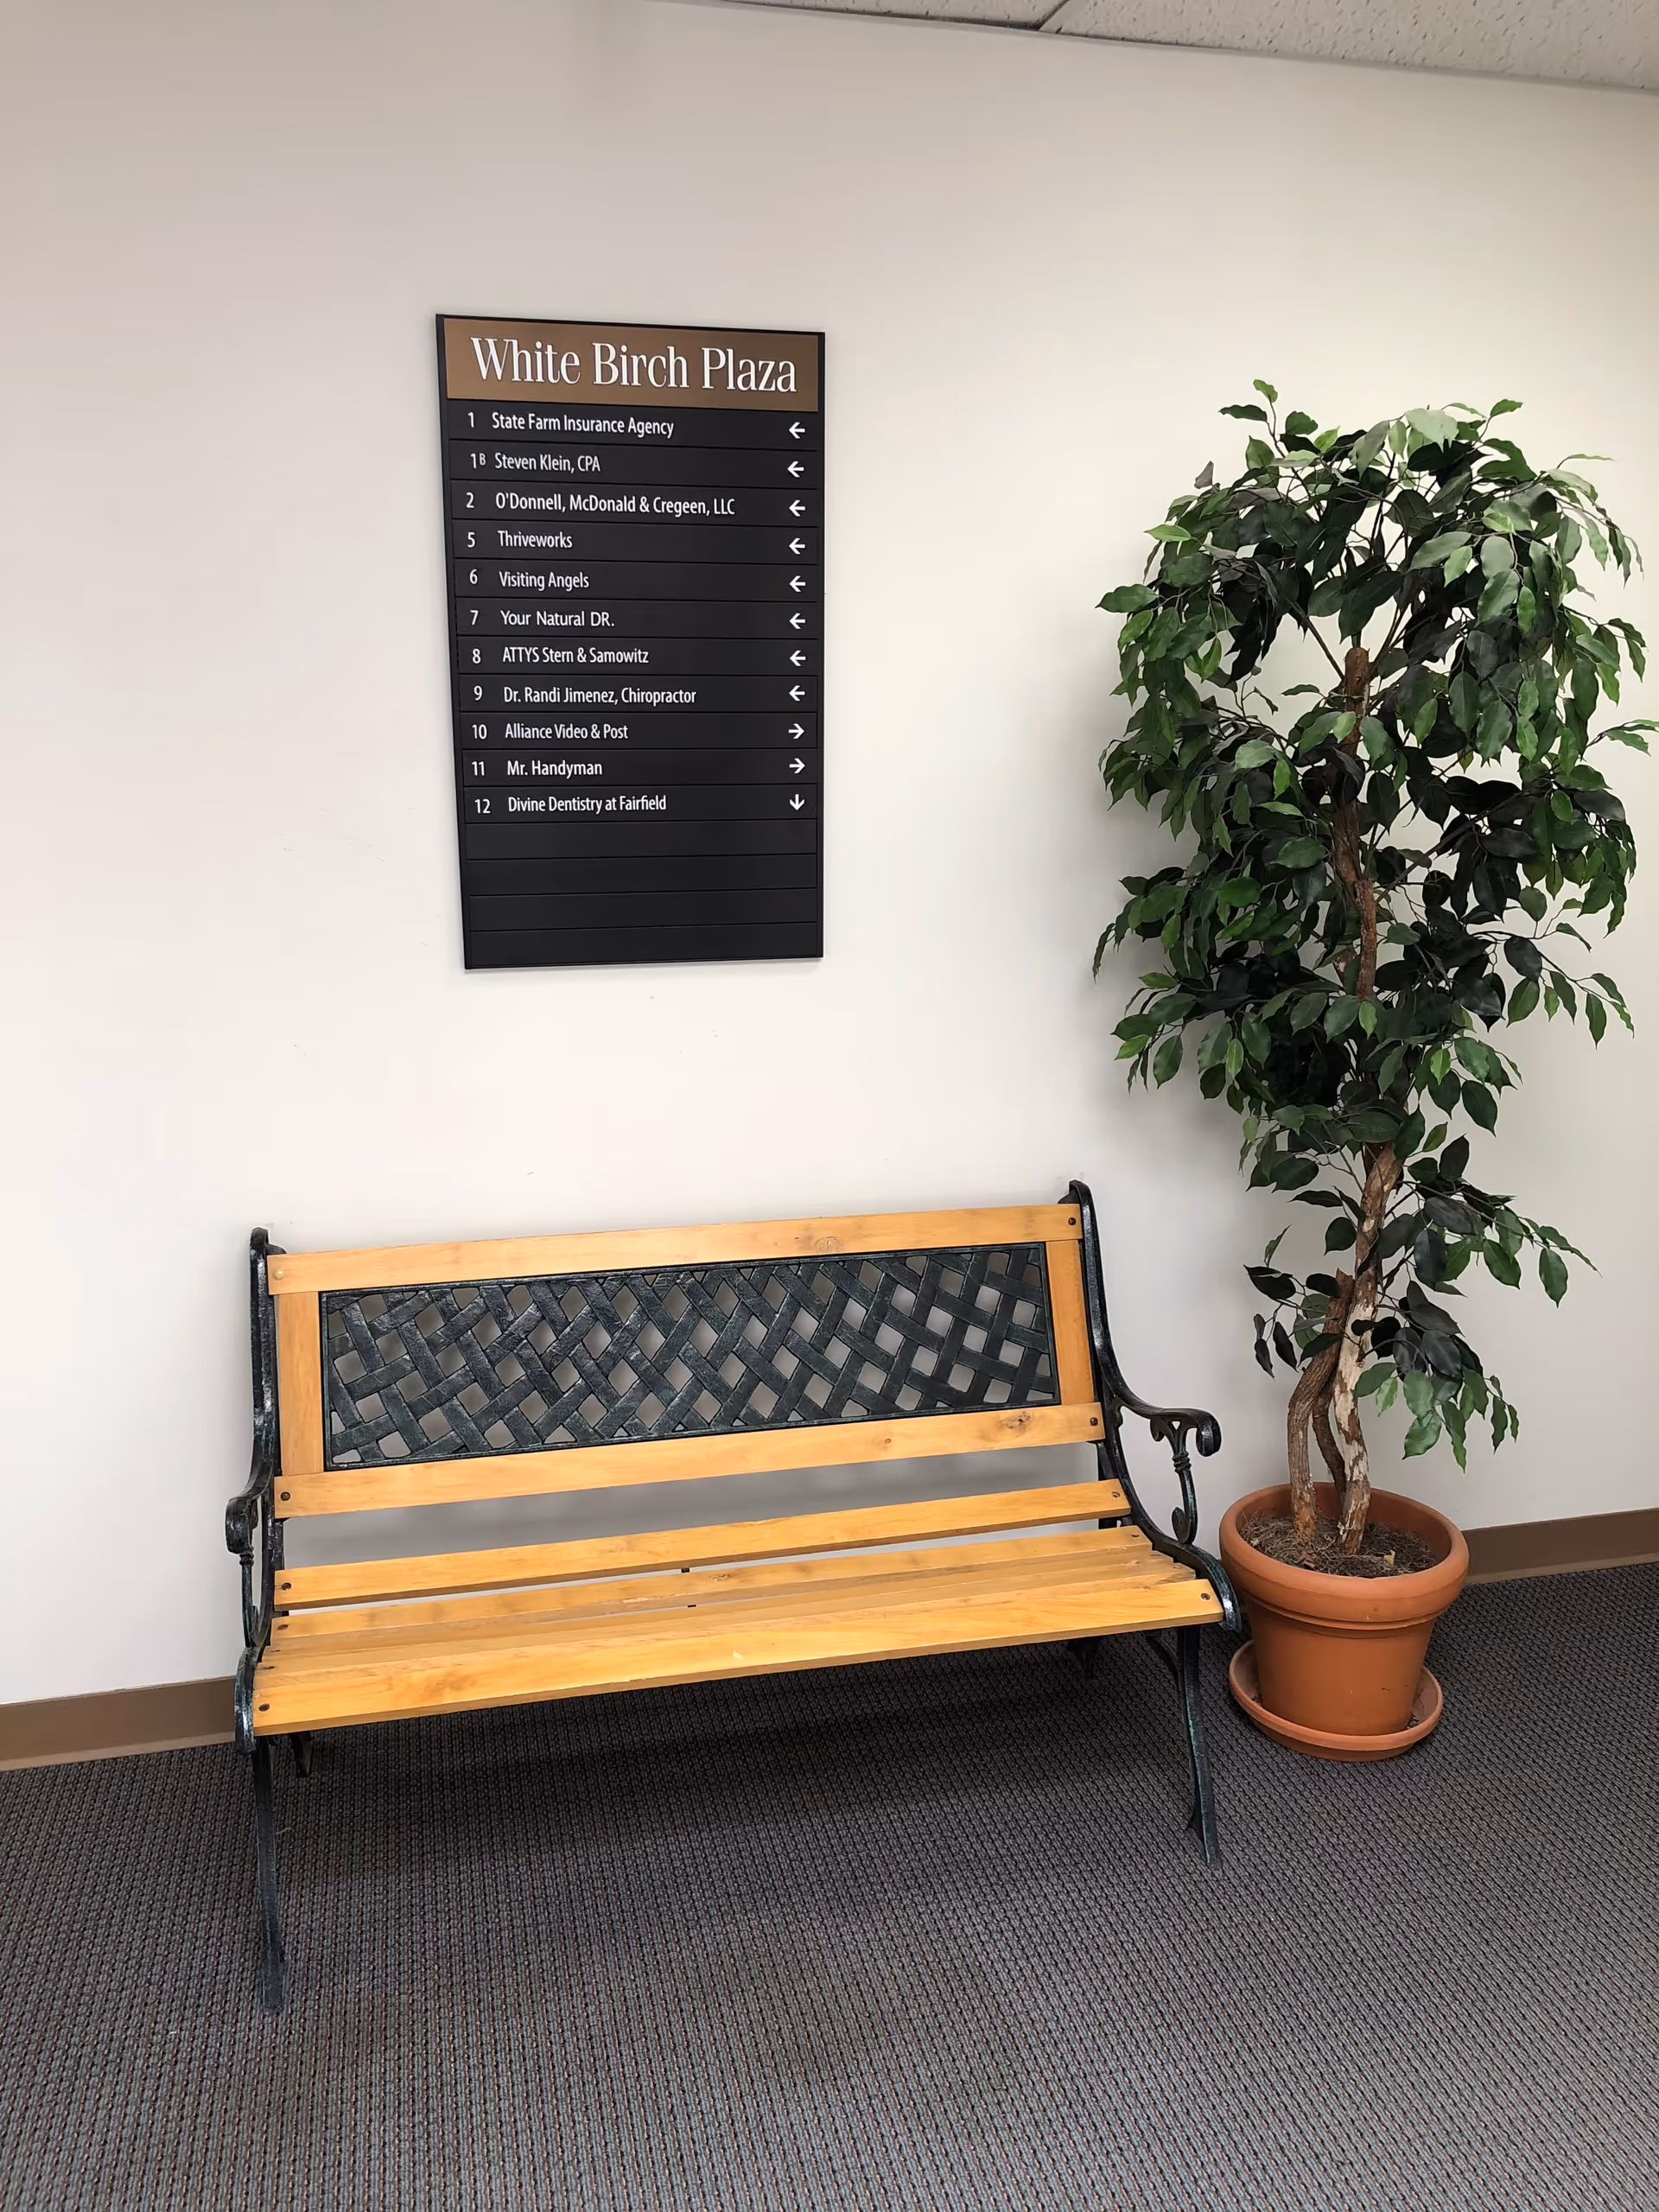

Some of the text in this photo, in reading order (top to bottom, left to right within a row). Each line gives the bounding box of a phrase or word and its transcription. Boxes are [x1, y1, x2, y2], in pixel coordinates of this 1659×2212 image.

[471, 337, 797, 392] White Birch Plaza
[468, 411, 674, 439] 1 State Farm Insurance Agency
[470, 452, 601, 474] 1B Steven Klein, CPA
[466, 492, 735, 518] 2 O'Donnell, McDonald & Cregeen, LLC
[467, 530, 573, 550] 5 Thriveworks
[469, 569, 589, 592] 6 Visiting Angels
[470, 609, 615, 627] 7 Your Natural DR.
[472, 646, 649, 664] 8 ATTYS Stern & Samowitz
[474, 685, 697, 707] 9 Dr. Randi Jimenez, Chiropractor
[471, 722, 629, 740] 10 Alliance Video & Post
[471, 760, 603, 779] 11 Mr. Handyman
[474, 793, 667, 815] 12 Divine Dentistry at Fairfield
